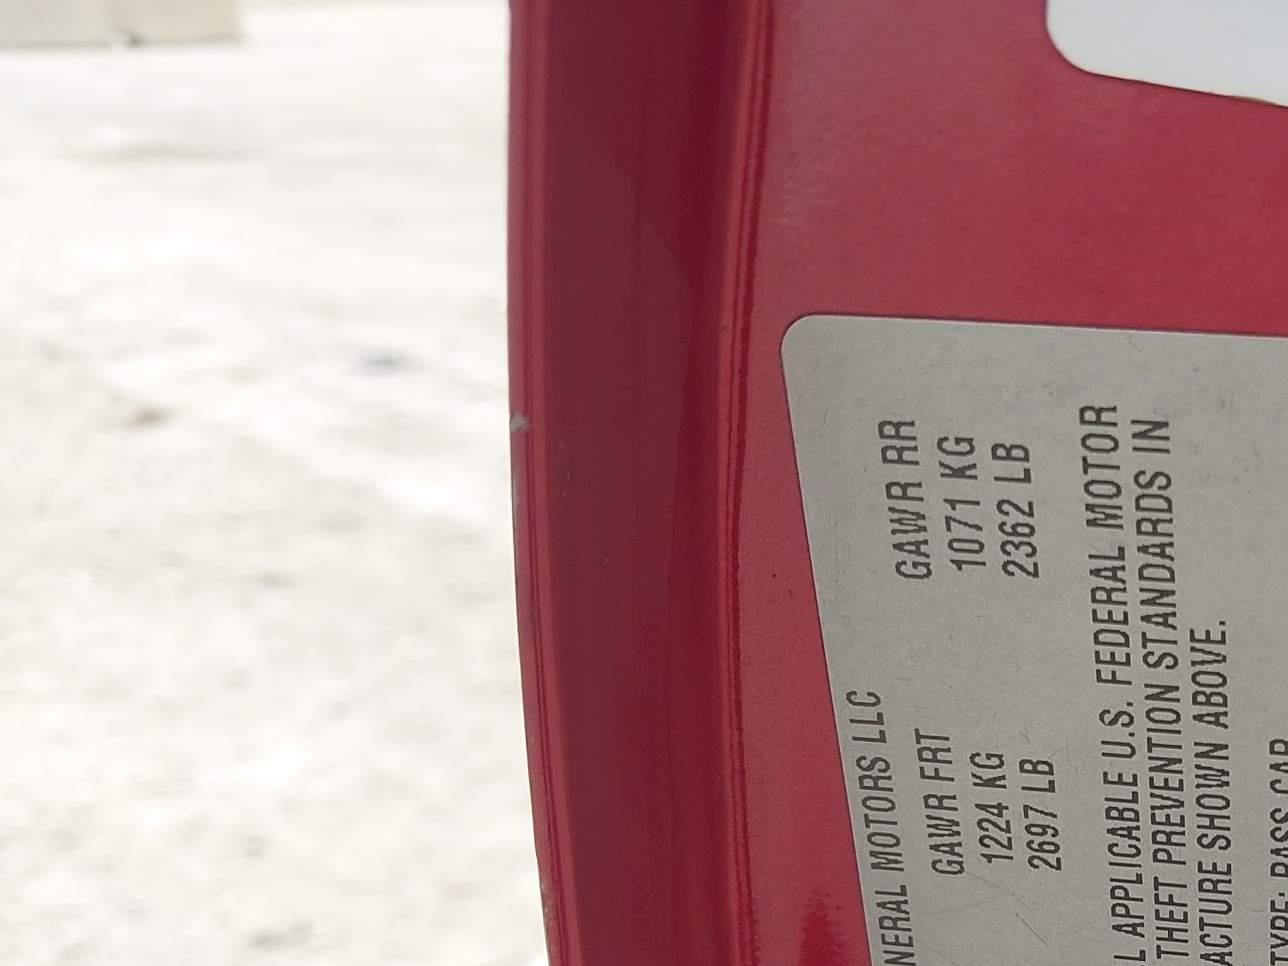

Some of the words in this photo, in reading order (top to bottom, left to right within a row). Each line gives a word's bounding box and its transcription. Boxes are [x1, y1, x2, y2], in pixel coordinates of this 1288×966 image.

[878, 420, 920, 466] RR
[937, 436, 978, 480] KG
[991, 443, 1032, 484] LB
[1079, 406, 1124, 530] MOTOR
[1130, 420, 1170, 454] IN
[885, 482, 932, 580] GAWR
[943, 498, 986, 571] 1071
[996, 499, 1039, 578] 2362
[1134, 470, 1178, 670] STANDARDS
[1088, 546, 1132, 685] FEDERAL
[1190, 621, 1228, 729] ABOVE.
[846, 691, 886, 743] LLC
[914, 728, 954, 782] FRT
[1099, 702, 1136, 759] U.S.
[969, 752, 1007, 789] KG
[1019, 759, 1056, 793] LB
[1144, 684, 1186, 866] PREVENTION
[1194, 742, 1231, 850] SHOWN
[856, 756, 904, 872] MOTORS
[923, 794, 965, 875] GAWR
[974, 802, 1014, 863] 1224
[1023, 804, 1062, 871] 2697
[1103, 771, 1145, 938] APPLICABLE
[1154, 876, 1189, 959] THEFT
